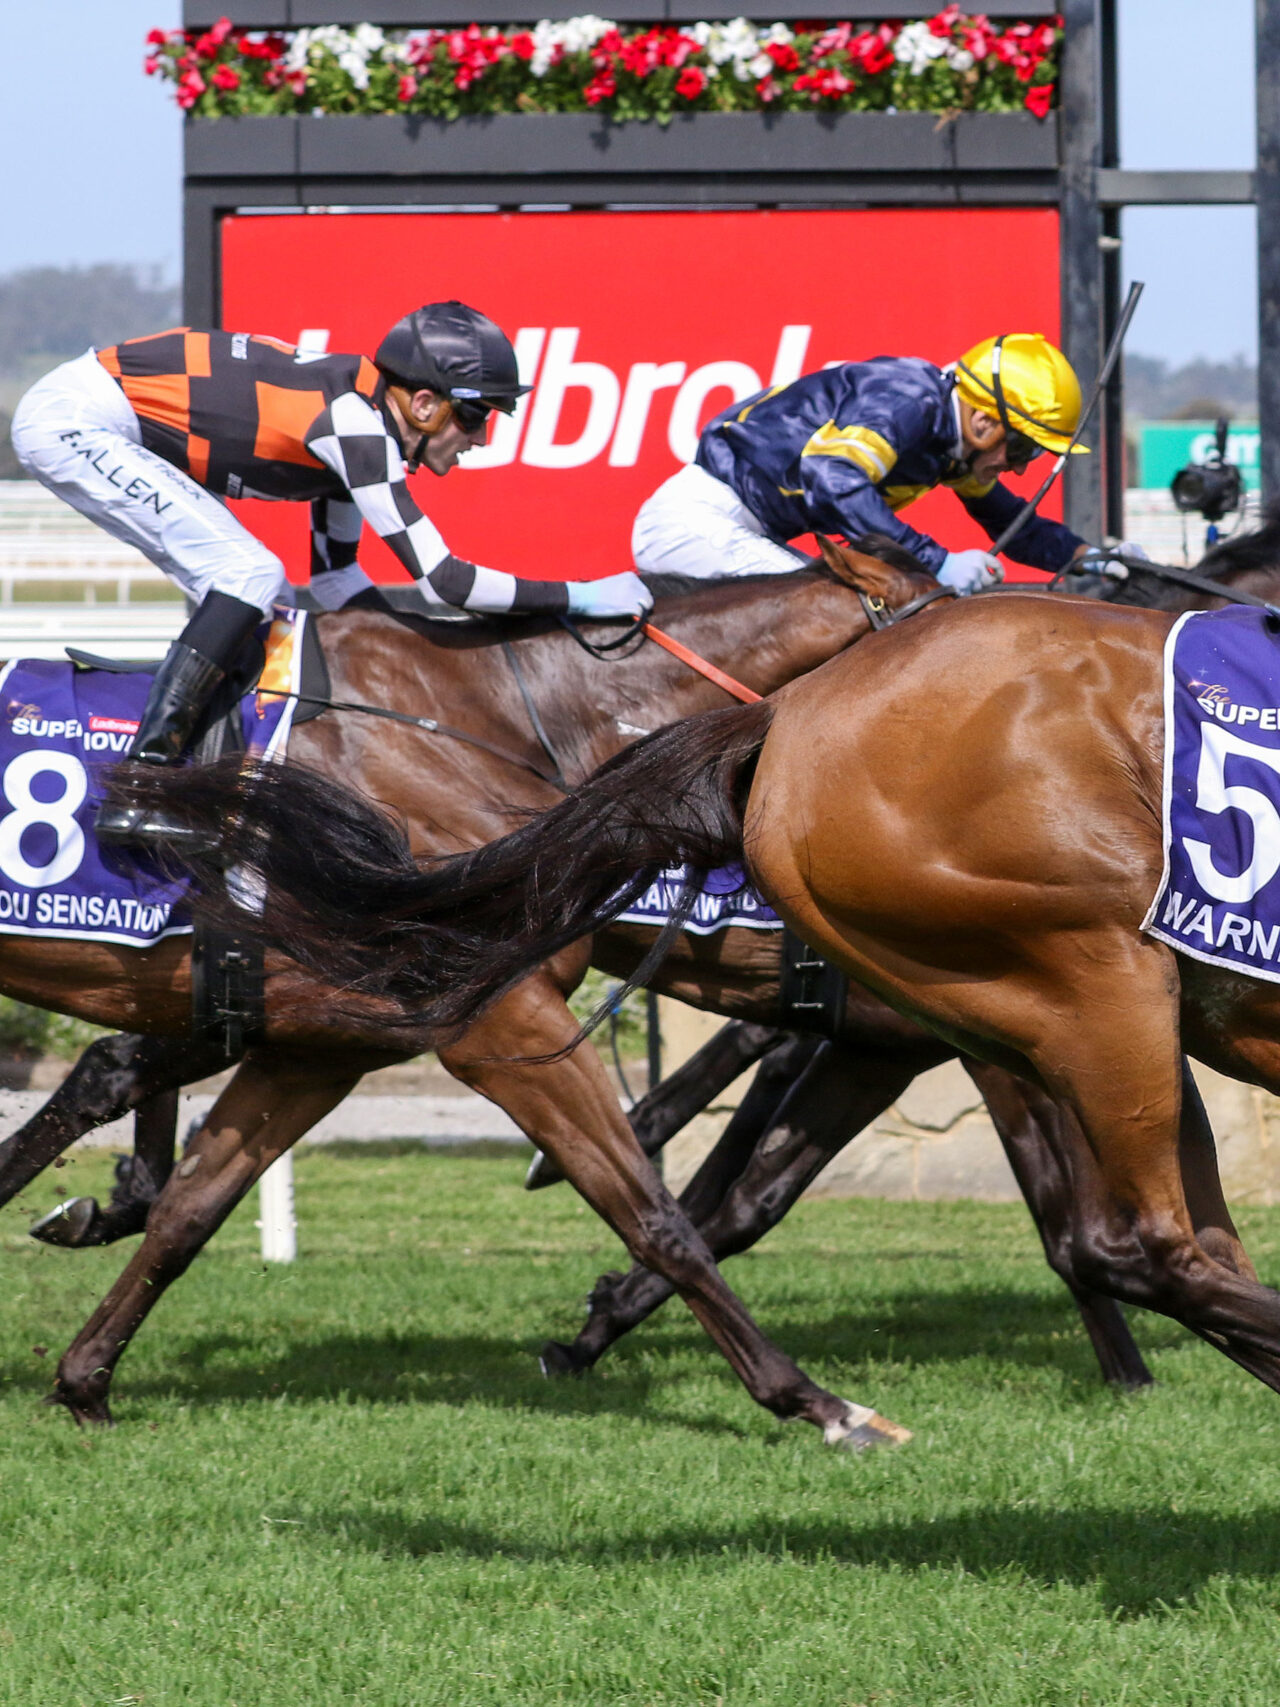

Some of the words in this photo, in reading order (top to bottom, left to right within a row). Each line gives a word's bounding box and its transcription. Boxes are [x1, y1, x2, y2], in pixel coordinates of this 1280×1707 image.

[1187, 679, 1232, 705] The
[0, 749, 88, 888] 8
[0, 890, 30, 921] OU
[36, 892, 171, 933] SENSATION
